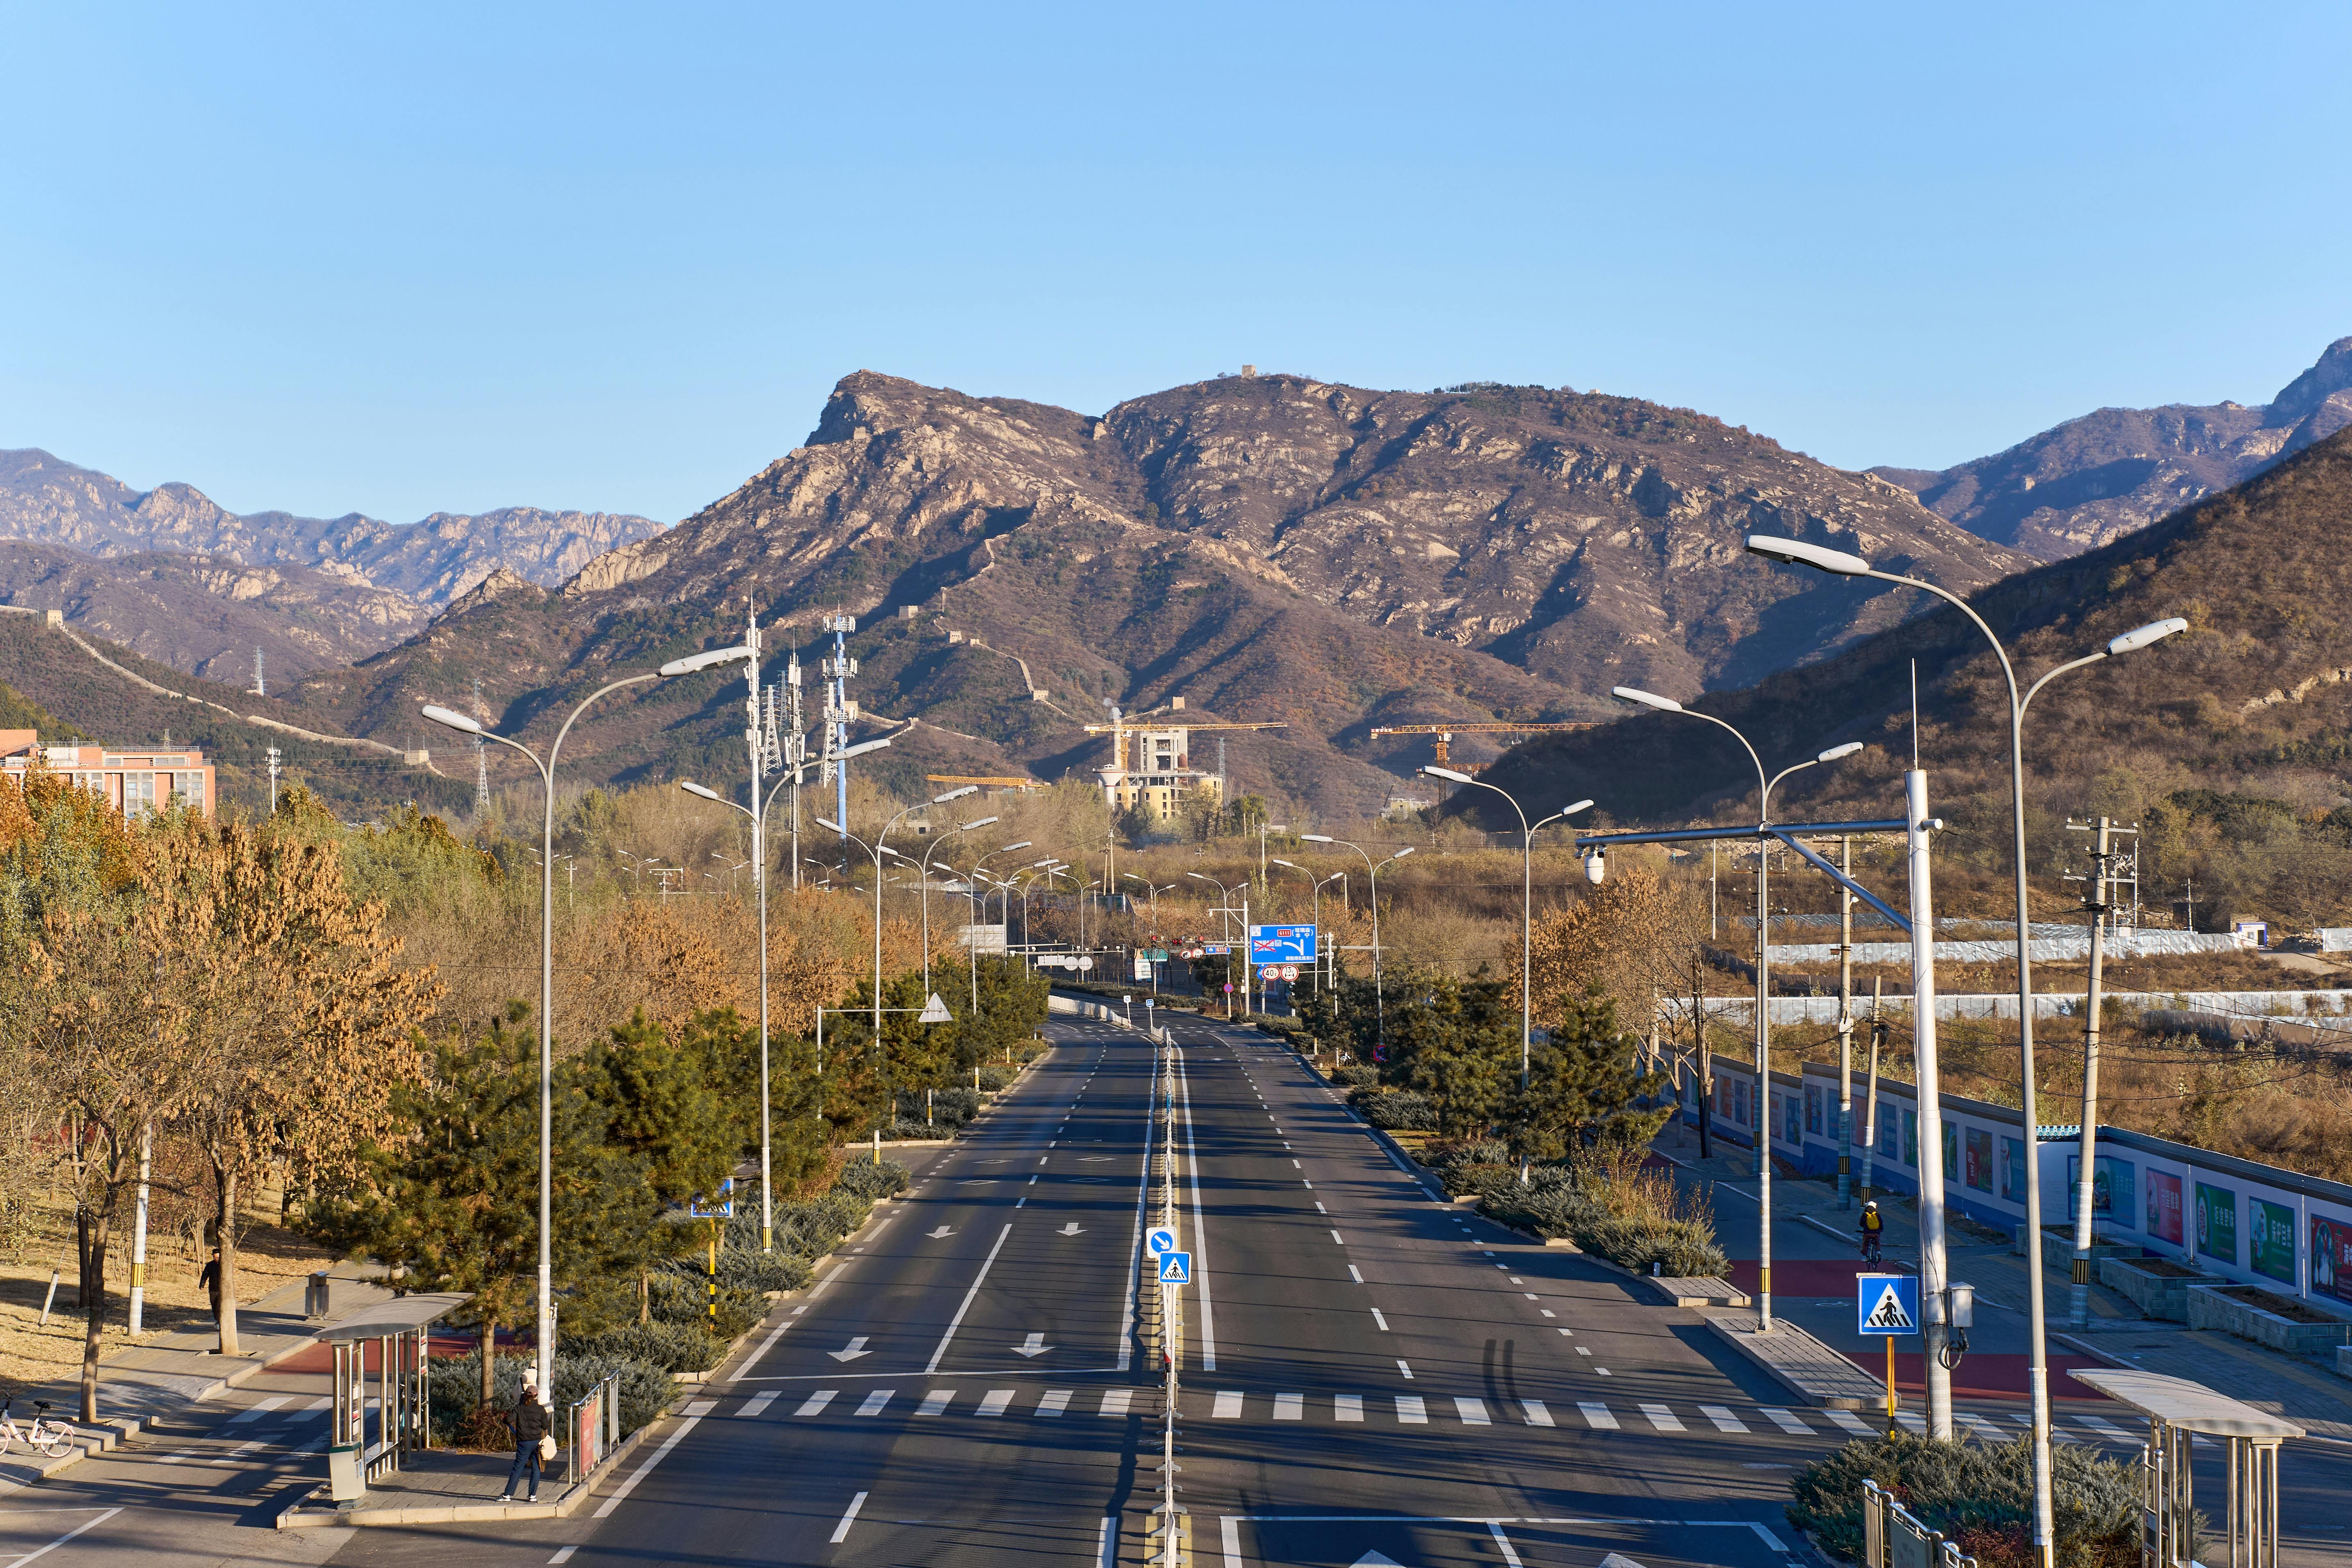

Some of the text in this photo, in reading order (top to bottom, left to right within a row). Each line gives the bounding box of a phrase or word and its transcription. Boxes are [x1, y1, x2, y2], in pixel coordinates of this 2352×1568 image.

[2161, 1189, 2180, 1211] 守望相助
[2214, 1205, 2234, 1229] 拒食野味
[2272, 1219, 2292, 1247] 保护自然
